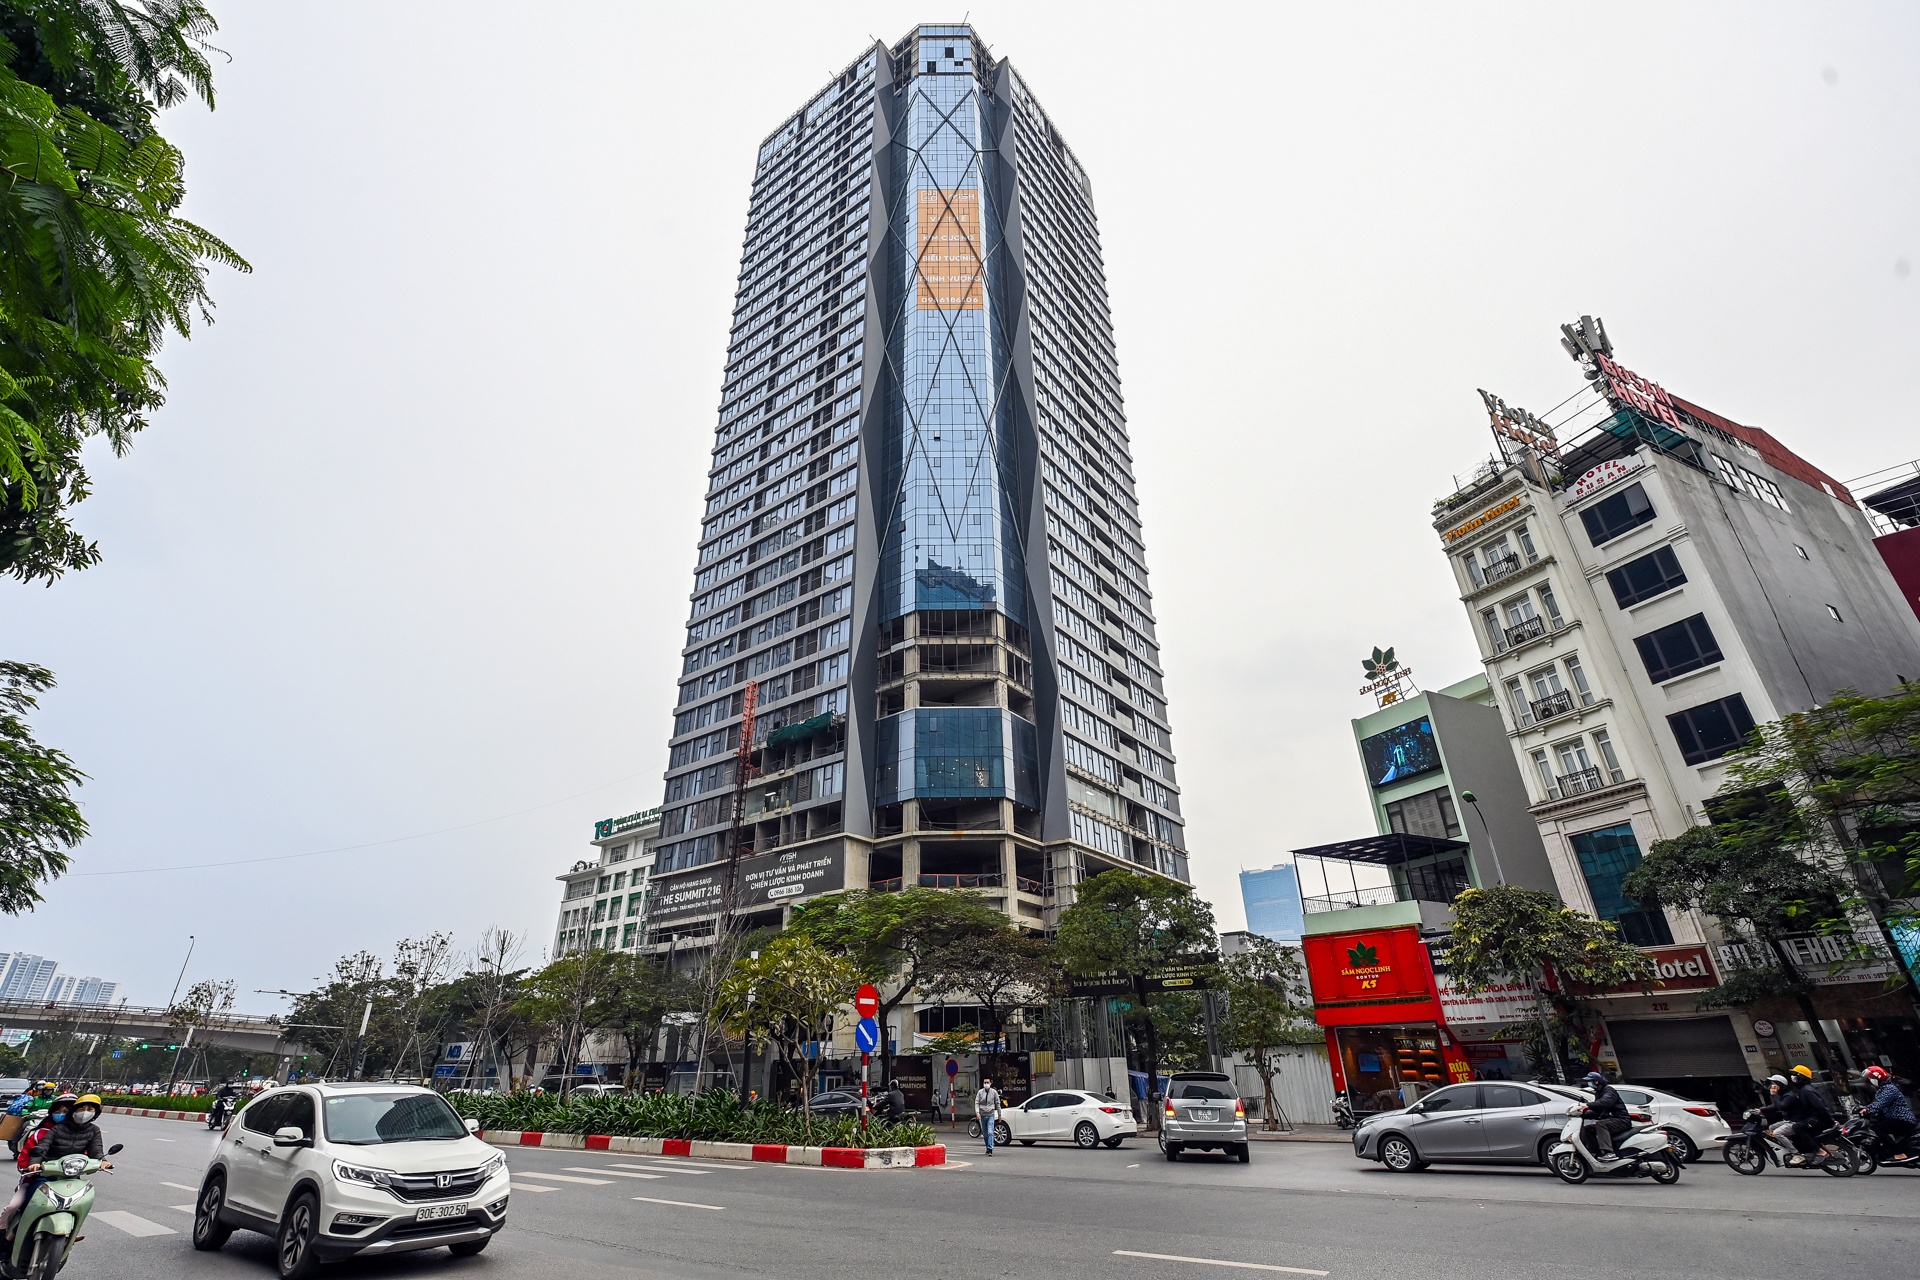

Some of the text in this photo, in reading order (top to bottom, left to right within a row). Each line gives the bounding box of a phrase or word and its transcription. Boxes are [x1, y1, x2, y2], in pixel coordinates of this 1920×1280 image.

[944, 255, 976, 263] TƯỢNG
[947, 275, 981, 283] VƯỢNG
[1598, 352, 1675, 408] BUSAN
[1477, 388, 1558, 441] Violin
[1609, 376, 1687, 433] HOTEL
[1576, 465, 1627, 495] BUSAN
[1577, 460, 1619, 486] HOTEL
[1445, 495, 1520, 543] Violin Hotel
[745, 856, 832, 882] ĐƠN VỊ TƯ VẤN VÀ PHÁT TRIỂN
[750, 869, 824, 890] CHIẾN LƯỢC KINH DOANH
[660, 893, 674, 906] THE
[674, 886, 707, 903] SUMMIT
[706, 884, 722, 897] 216
[1341, 965, 1391, 976] SÂM NGỌC LINH
[1361, 979, 1377, 989] K5
[1652, 1003, 1670, 1011] 212
[1448, 1058, 1471, 1073] RỬA
[1456, 1073, 1470, 1083] XE
